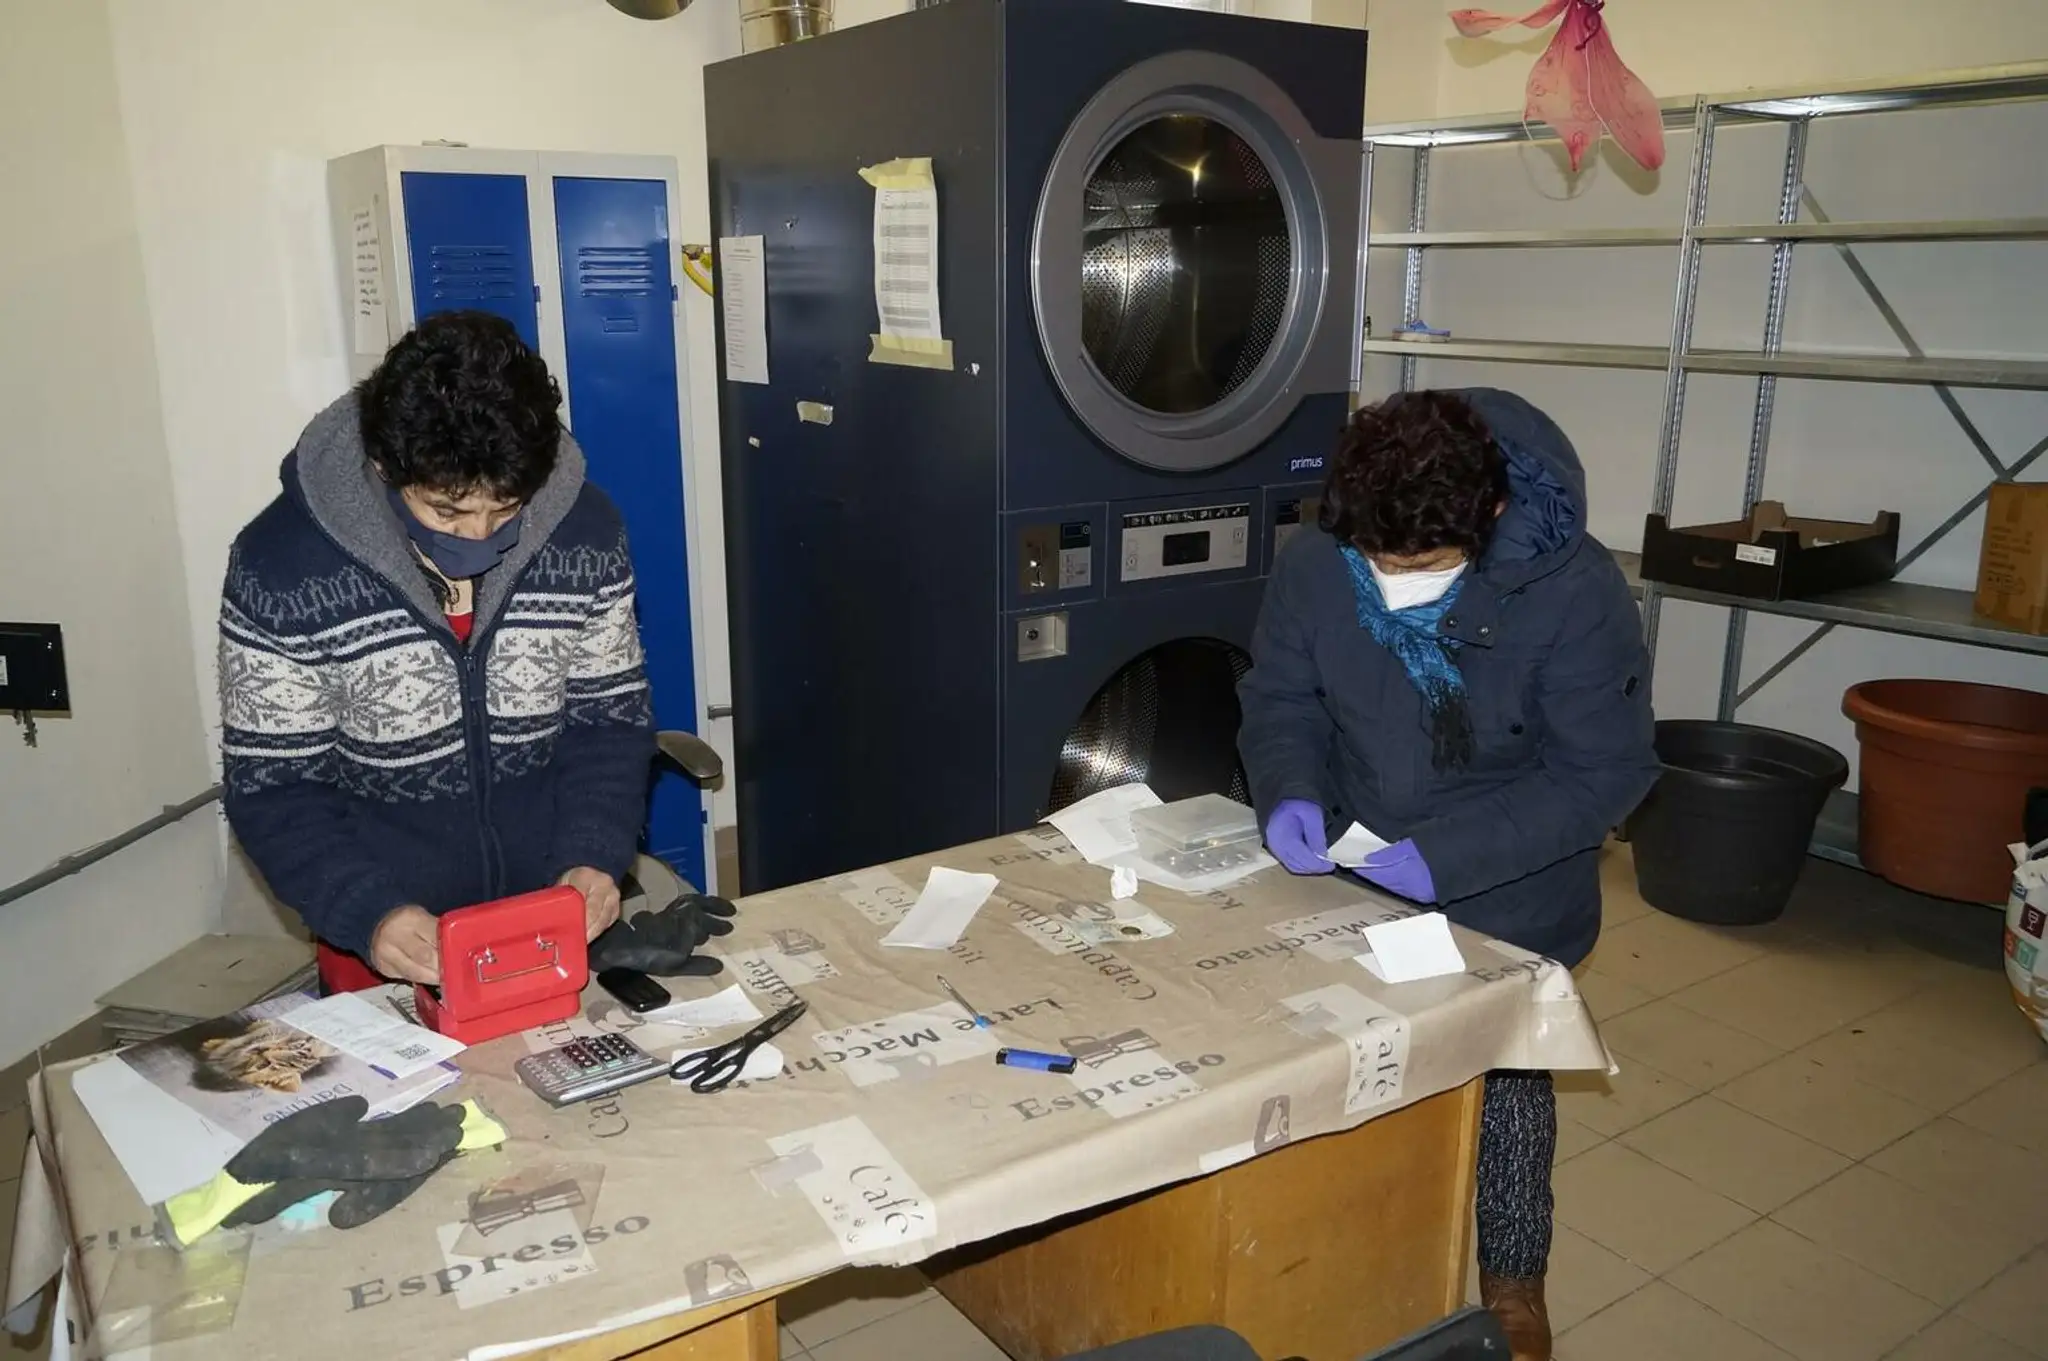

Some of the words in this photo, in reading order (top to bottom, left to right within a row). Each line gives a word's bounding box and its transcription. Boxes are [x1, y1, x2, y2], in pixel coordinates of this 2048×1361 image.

[1290, 456, 1323, 472] primus
[1007, 899, 1157, 1000] Cappuccino
[1009, 1053, 1226, 1122] Espresso
[1366, 1016, 1401, 1098] Café
[849, 1165, 925, 1234] Café
[342, 1215, 651, 1314] Espresso
